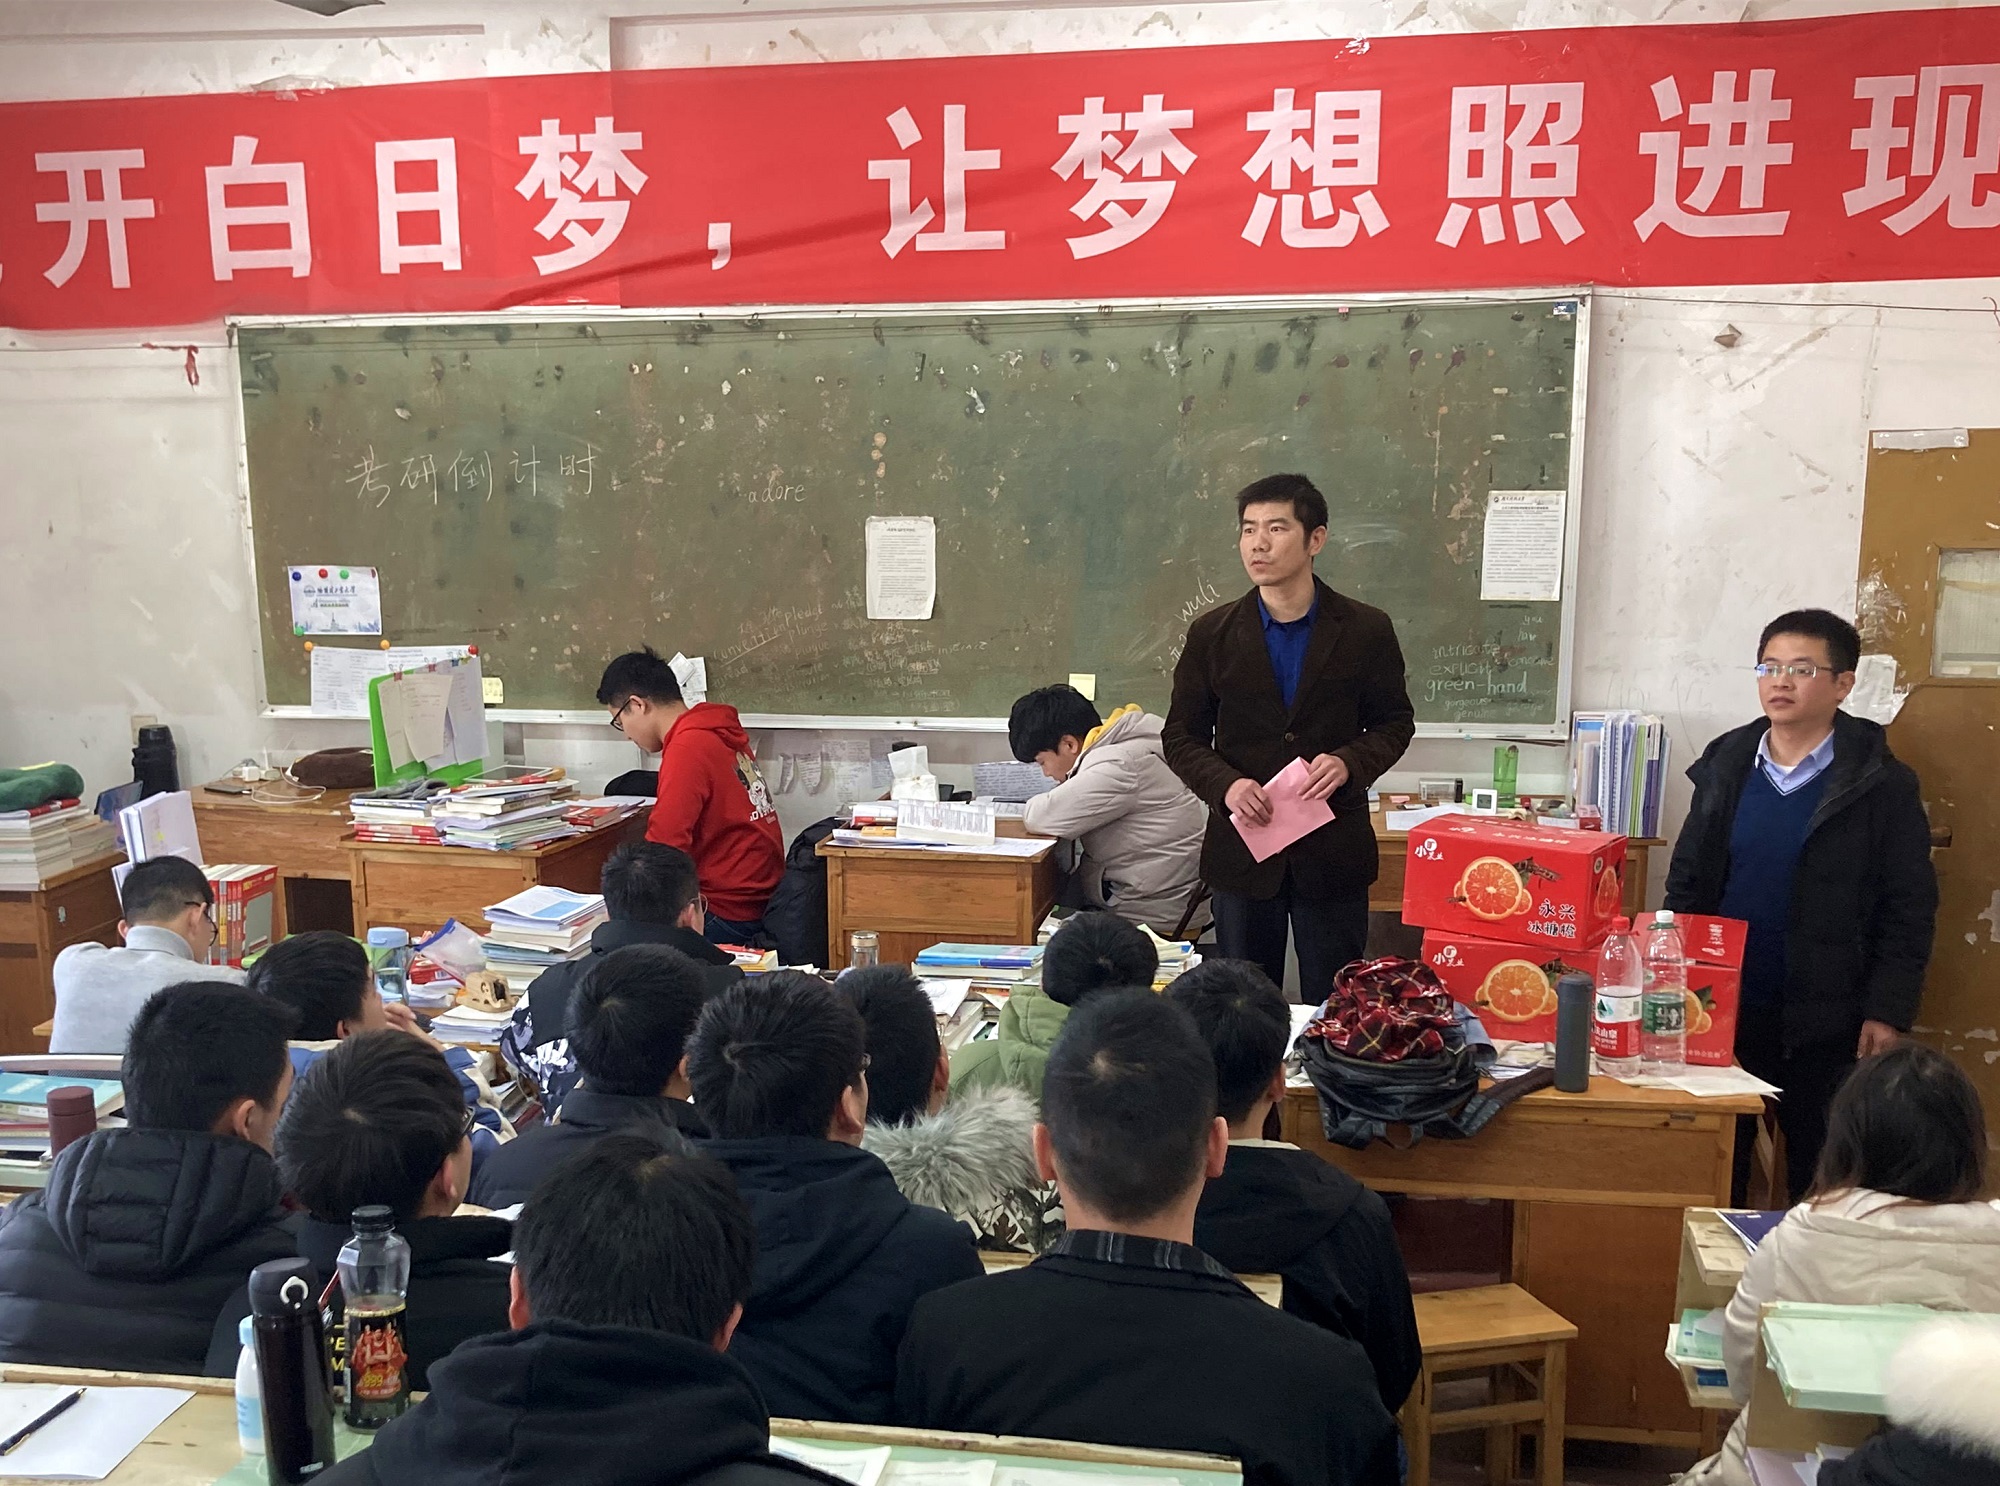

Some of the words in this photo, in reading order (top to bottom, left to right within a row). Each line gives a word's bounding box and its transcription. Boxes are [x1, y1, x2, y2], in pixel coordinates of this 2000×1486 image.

[0, 64, 2000, 289] 开白日梦，让梦想照进现
[344, 442, 599, 508] 考研倒计时
[747, 481, 808, 504] adore
[1424, 670, 1528, 702] green-hand
[1538, 897, 1576, 921] 永兴
[1527, 920, 1576, 939] 冰糖橙
